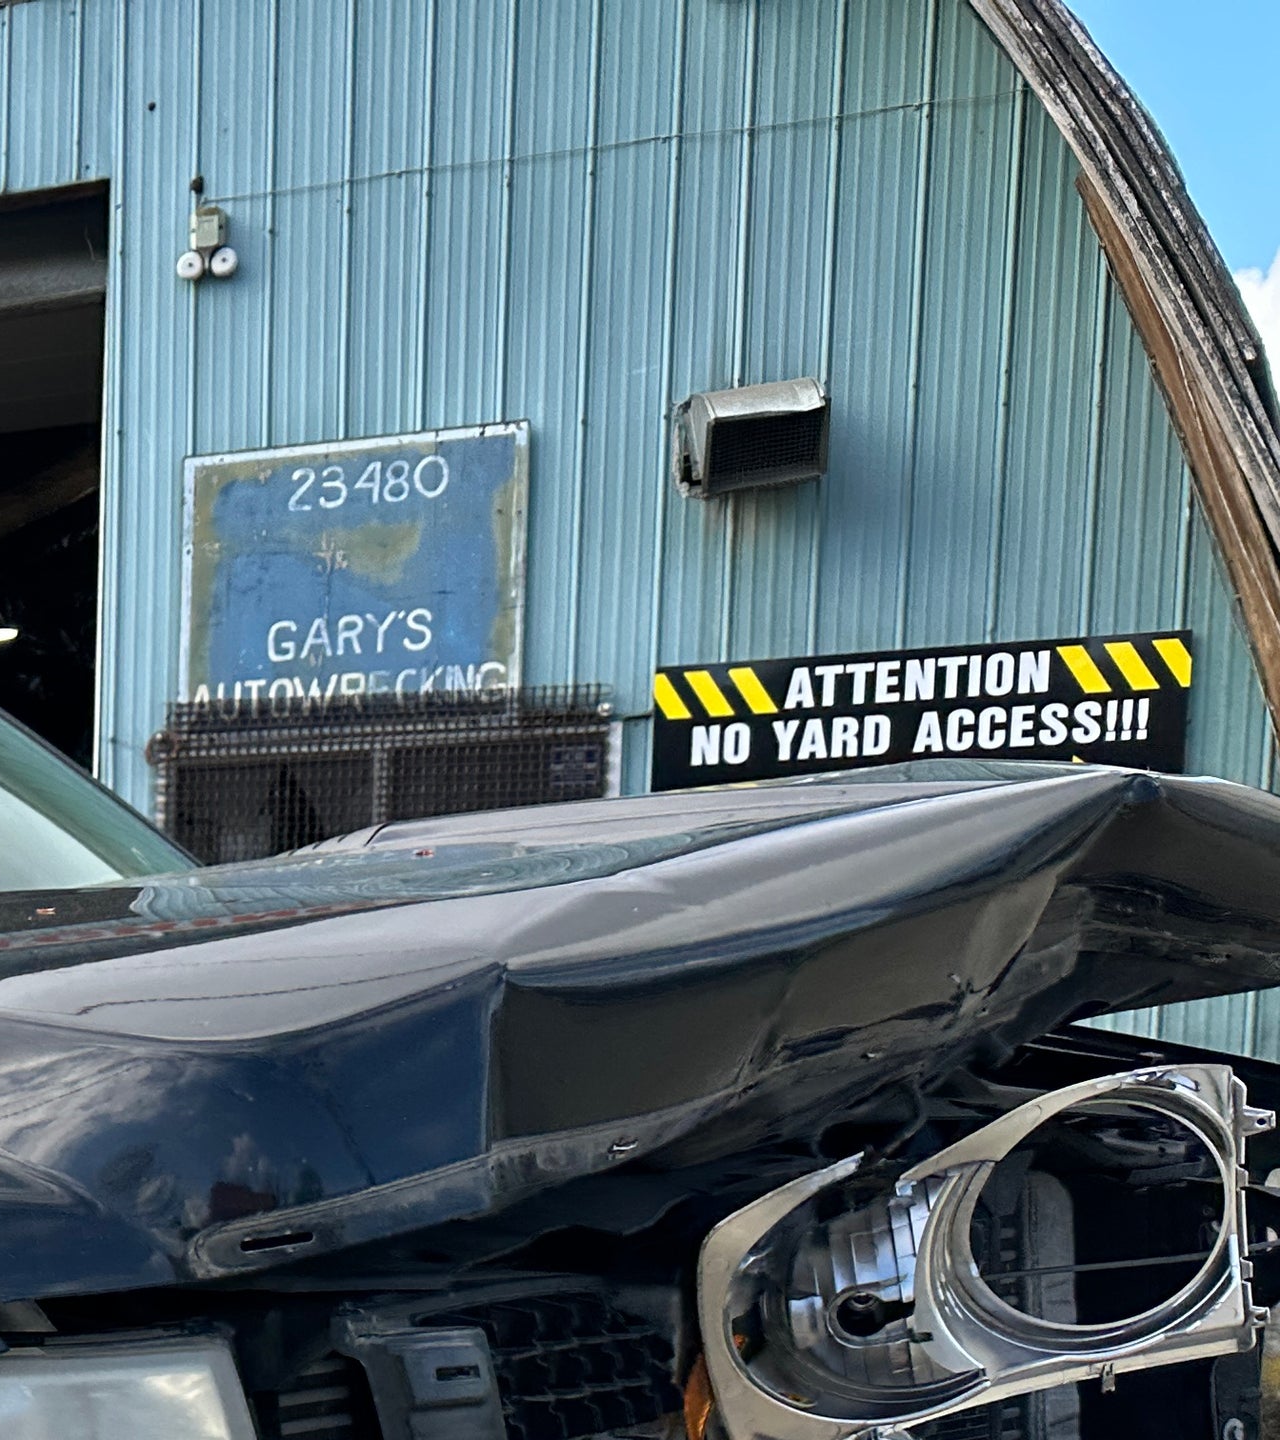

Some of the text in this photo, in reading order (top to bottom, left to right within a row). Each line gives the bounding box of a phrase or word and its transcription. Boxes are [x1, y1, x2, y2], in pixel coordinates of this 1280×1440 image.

[288, 455, 450, 511] 23480
[268, 608, 433, 662] GARY'S
[784, 650, 1051, 710] ATTENTION
[691, 698, 1150, 766] NO YARD ACCESS!!!
